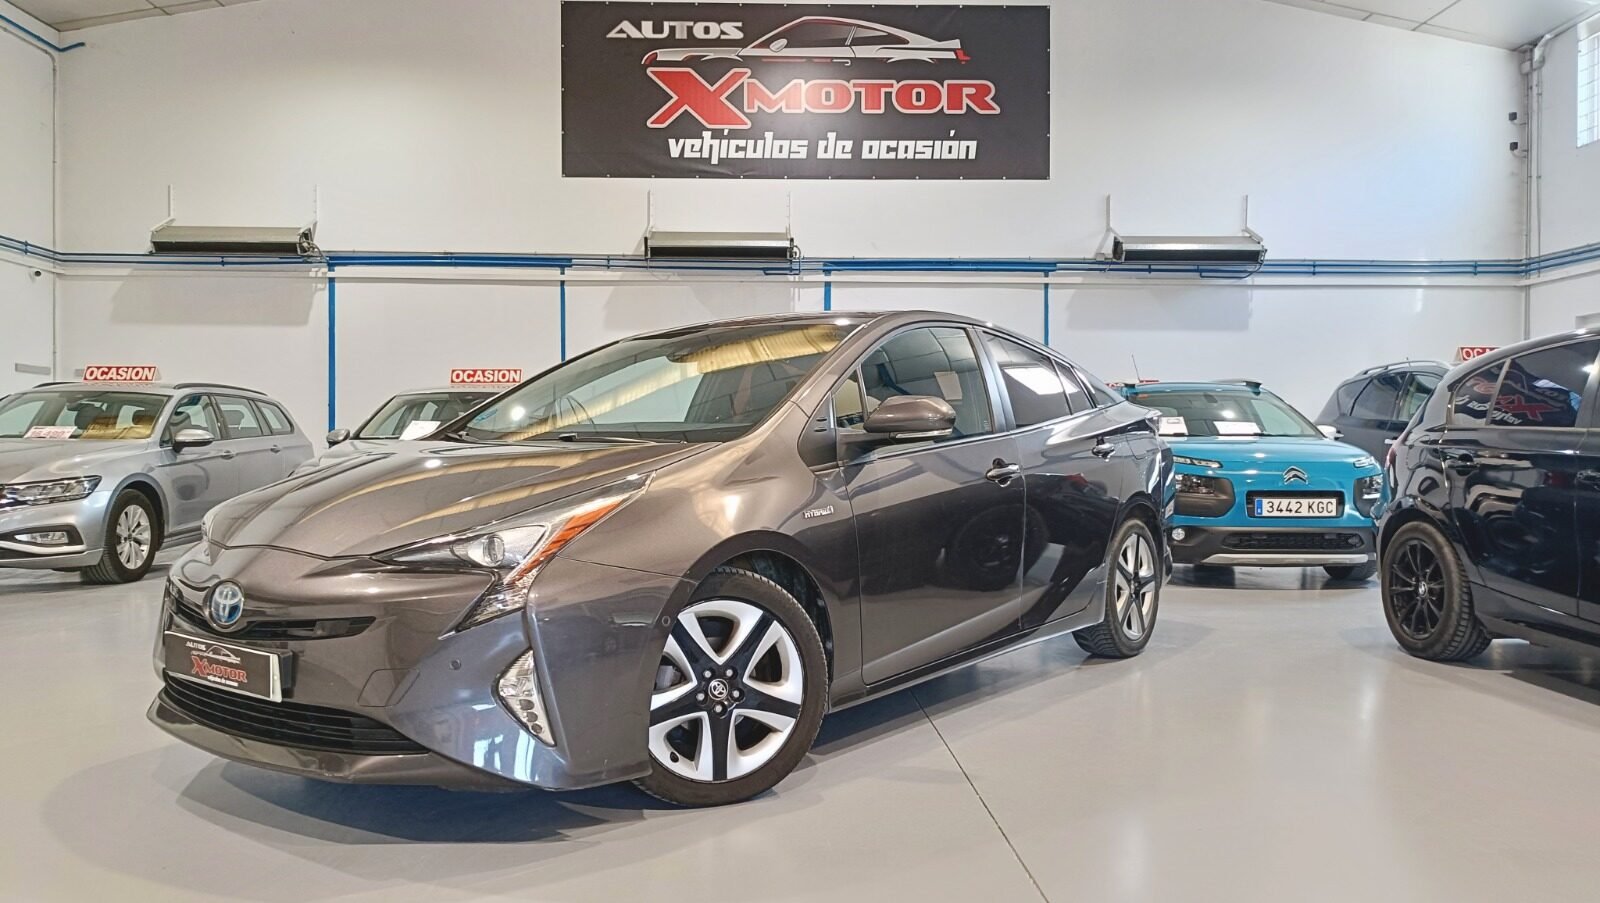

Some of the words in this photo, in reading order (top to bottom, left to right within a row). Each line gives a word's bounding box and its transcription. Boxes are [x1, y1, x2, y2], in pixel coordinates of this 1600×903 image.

[606, 20, 744, 39] AUTOS
[647, 67, 1000, 129] XMOTOR
[668, 129, 808, 164] vehículos
[817, 132, 853, 159] de
[861, 130, 977, 160] ocasión
[85, 367, 155, 380] OCASION
[452, 370, 521, 382] OCASION
[1266, 501, 1303, 514] 3442
[1307, 501, 1334, 514] KGC
[192, 656, 247, 683] XMOTOR
